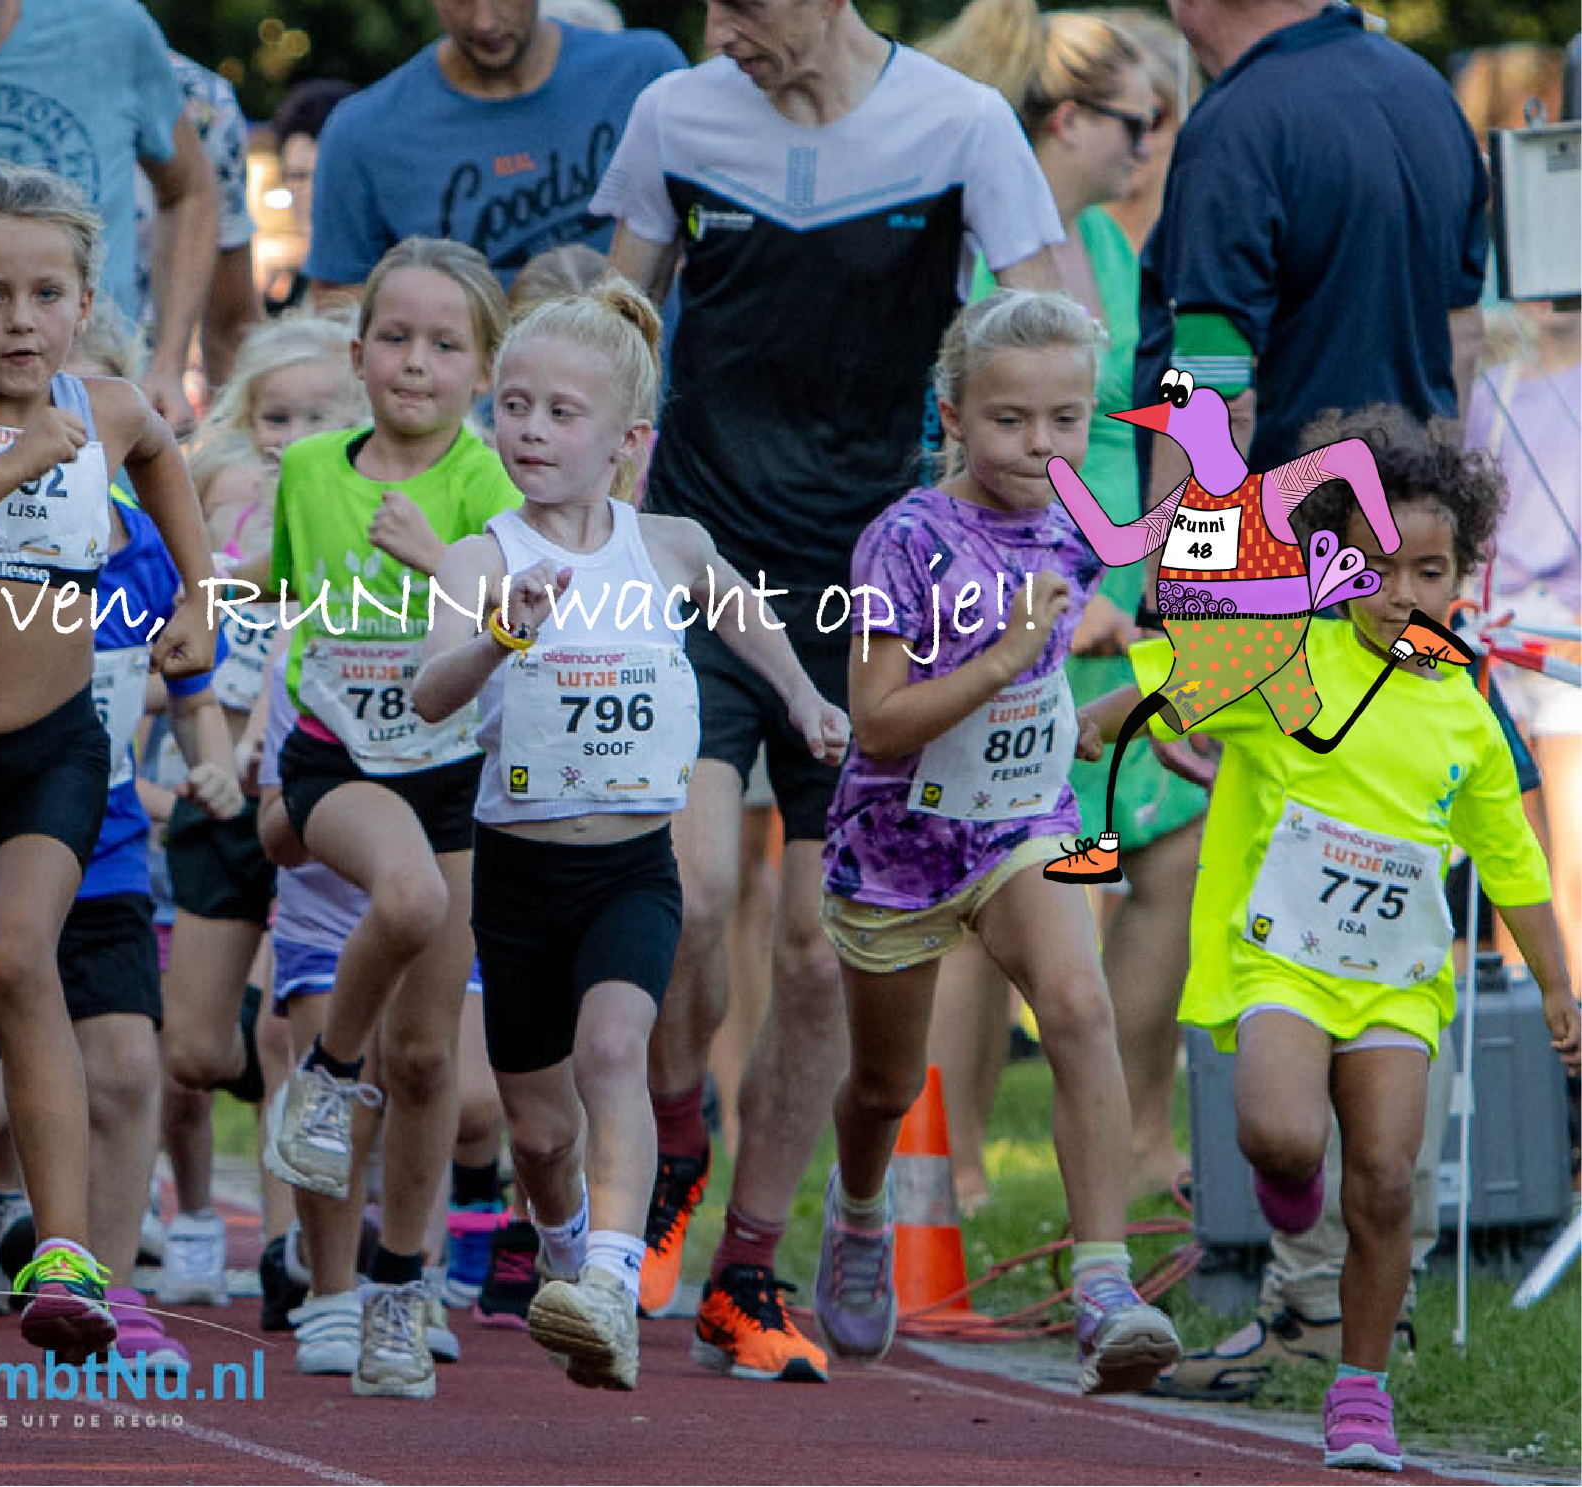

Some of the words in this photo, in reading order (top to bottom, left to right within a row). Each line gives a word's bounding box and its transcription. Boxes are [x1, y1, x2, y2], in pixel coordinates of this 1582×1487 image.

[7, 502, 48, 520] LISA
[346, 687, 416, 720] 78
[560, 693, 654, 734] 796
[583, 741, 635, 756] SOOF
[983, 719, 1056, 763] 801
[991, 762, 1043, 782] FEMKE
[1319, 866, 1408, 920] 775
[1337, 918, 1367, 936] ISA
